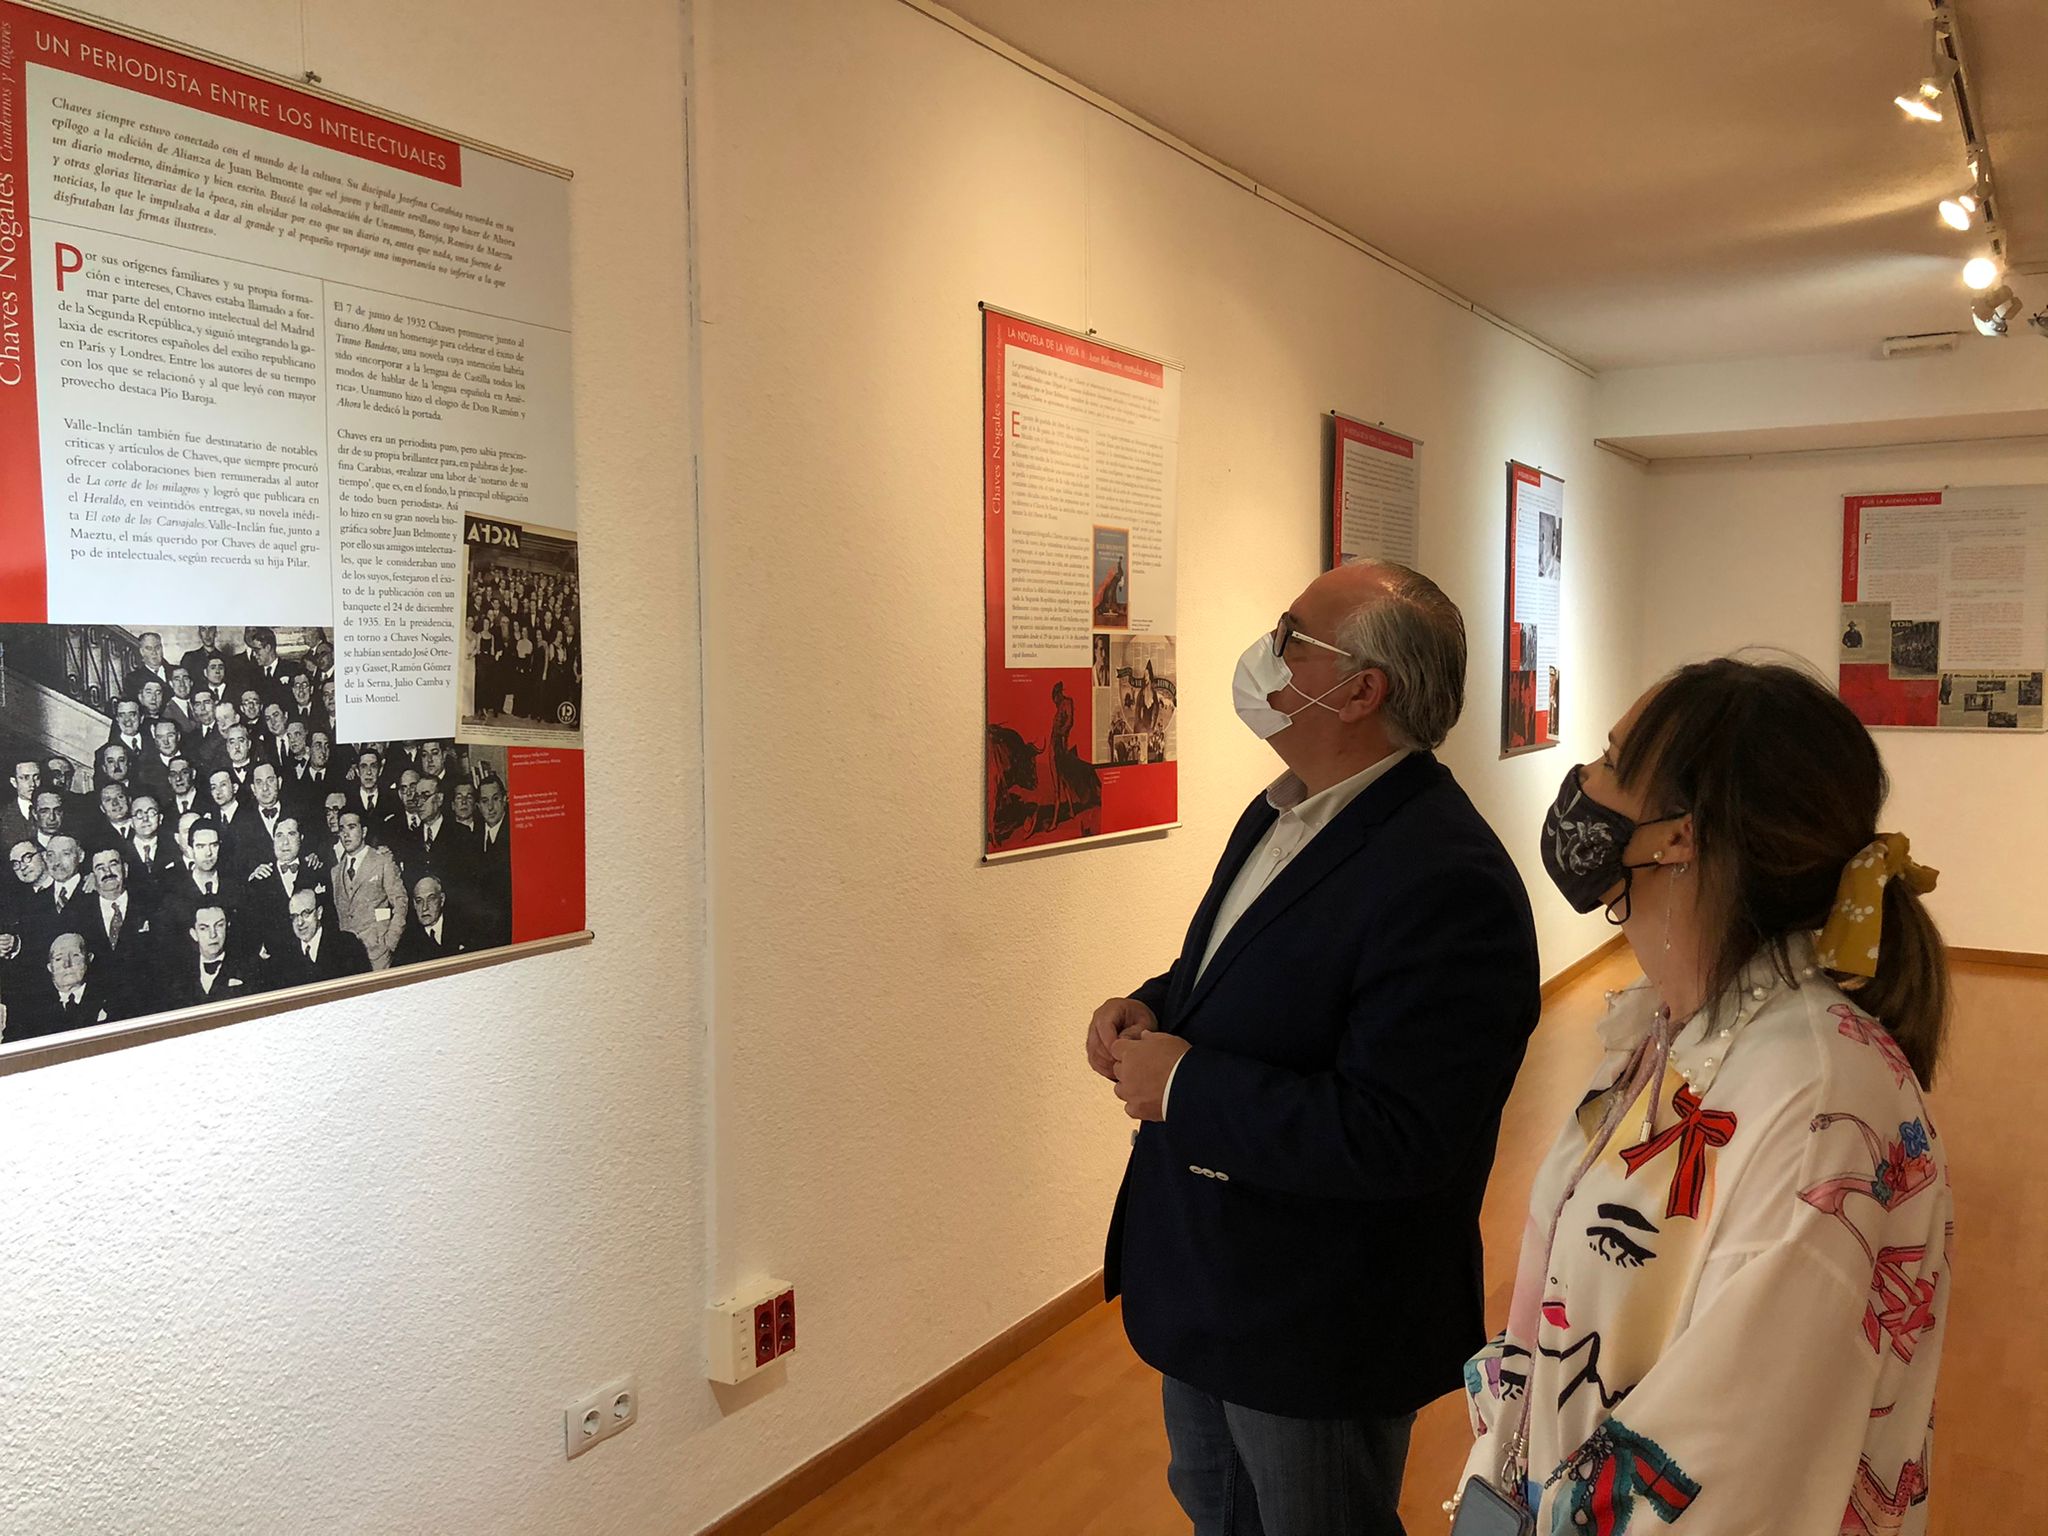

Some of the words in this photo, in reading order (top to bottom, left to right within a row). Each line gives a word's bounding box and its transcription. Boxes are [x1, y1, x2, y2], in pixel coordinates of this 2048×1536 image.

[0, 22, 16, 70] lugares
[1, 73, 15, 83] y
[36, 31, 70, 57] UN
[80, 43, 202, 96] PERIODISTA
[210, 83, 270, 117] ENTRE
[278, 104, 313, 130] LOS
[320, 117, 447, 171] INTELECTUALES
[0, 88, 13, 162] Cuadernos
[51, 96, 92, 116] Chaves
[96, 109, 136, 129] siempre
[139, 123, 171, 138] estuvo
[174, 132, 220, 151] conectado
[222, 146, 239, 157] con
[241, 149, 251, 160] el
[253, 154, 285, 169] mundo
[287, 161, 298, 173] de
[300, 164, 310, 176] la
[0, 173, 23, 281] Nogales
[53, 190, 115, 213] disfrutaban
[119, 203, 134, 217] las
[138, 208, 170, 225] firmas
[85, 269, 110, 283] ción
[114, 276, 121, 285] e
[124, 274, 174, 296] intereses,
[175, 285, 213, 302] Chaves
[215, 295, 246, 309] estaba
[247, 298, 287, 316] llamado
[287, 310, 294, 318] a
[296, 308, 314, 321] for-
[101, 255, 119, 266] sus
[121, 258, 168, 276] orígenes
[171, 266, 220, 286] familiares
[222, 280, 230, 291] y
[232, 282, 245, 291] su
[247, 285, 279, 299] propia
[57, 299, 73, 312] de
[74, 301, 85, 314] la
[87, 304, 135, 323] Segunda
[137, 312, 196, 334] República,
[195, 326, 203, 337] y
[204, 326, 236, 341] siguió
[236, 333, 290, 349] integrando
[290, 339, 299, 351] la
[300, 344, 316, 355] ga-
[86, 289, 109, 300] mar
[112, 293, 141, 306] parte
[143, 296, 160, 310] del
[163, 303, 206, 318] entorno
[208, 311, 261, 328] intelectual
[262, 319, 278, 331] del
[280, 321, 315, 338] Madrid
[0, 291, 21, 386] Chaves
[58, 317, 86, 333] laxia
[89, 322, 104, 335] de
[107, 329, 159, 344] escritores
[161, 338, 210, 353] españoles
[212, 343, 229, 356] del
[231, 348, 259, 361] exilio
[261, 354, 316, 370] republicano
[1007, 327, 1016, 339] LA
[1017, 330, 1045, 347] NOVELA
[1046, 338, 1055, 350] DE
[1055, 342, 1064, 354] LA
[59, 340, 74, 349] en
[78, 339, 106, 353] París
[109, 347, 116, 358] y
[120, 345, 166, 363] Londres.
[168, 353, 198, 368] Entre
[200, 357, 215, 370] los
[218, 364, 253, 377] autores
[255, 367, 268, 379] de
[270, 372, 281, 381] su
[283, 373, 317, 388] tiempo
[60, 358, 83, 369] con
[87, 358, 104, 371] los
[107, 365, 129, 377] que
[132, 368, 144, 377] se
[146, 368, 196, 385] relacionó
[198, 378, 206, 389] y
[209, 377, 218, 388] al
[221, 382, 240, 393] que
[243, 381, 264, 396] leyó
[266, 388, 285, 398] con
[288, 391, 317, 403] mayor
[61, 376, 116, 391] provecho
[118, 380, 157, 397] destaca
[160, 386, 179, 399] Pío
[181, 389, 217, 407] Baroja.
[63, 417, 133, 436] Valle-Inclán
[137, 427, 180, 441] también
[184, 431, 201, 444] fue
[205, 434, 262, 451] destinatario
[265, 441, 278, 453] de
[280, 444, 319, 457] notables
[992, 403, 1004, 459] Nogales
[992, 464, 1001, 515] Chaves
[70, 548, 86, 560] po
[89, 546, 103, 558] de
[106, 547, 177, 563] intelectuales,
[177, 551, 208, 566] según
[210, 554, 252, 565] recuerda
[254, 558, 265, 566] su
[267, 555, 285, 569] hija
[286, 556, 310, 568] Pilar.
[467, 522, 519, 548] AHORA
[343, 634, 355, 642] en
[356, 634, 381, 642] torno
[390, 632, 419, 642] Chaves
[343, 650, 353, 658] se
[353, 647, 381, 658] habían
[381, 647, 413, 657] sentado
[411, 647, 429, 660] José
[343, 666, 354, 676] ga
[354, 665, 361, 676] y
[391, 662, 422, 673] Ramón
[422, 662, 452, 672] Gómez
[343, 678, 355, 689] de
[357, 678, 365, 689] la
[393, 677, 414, 690] Julio
[415, 676, 444, 687] Camba
[445, 679, 451, 688] y
[344, 694, 363, 704] Luis
